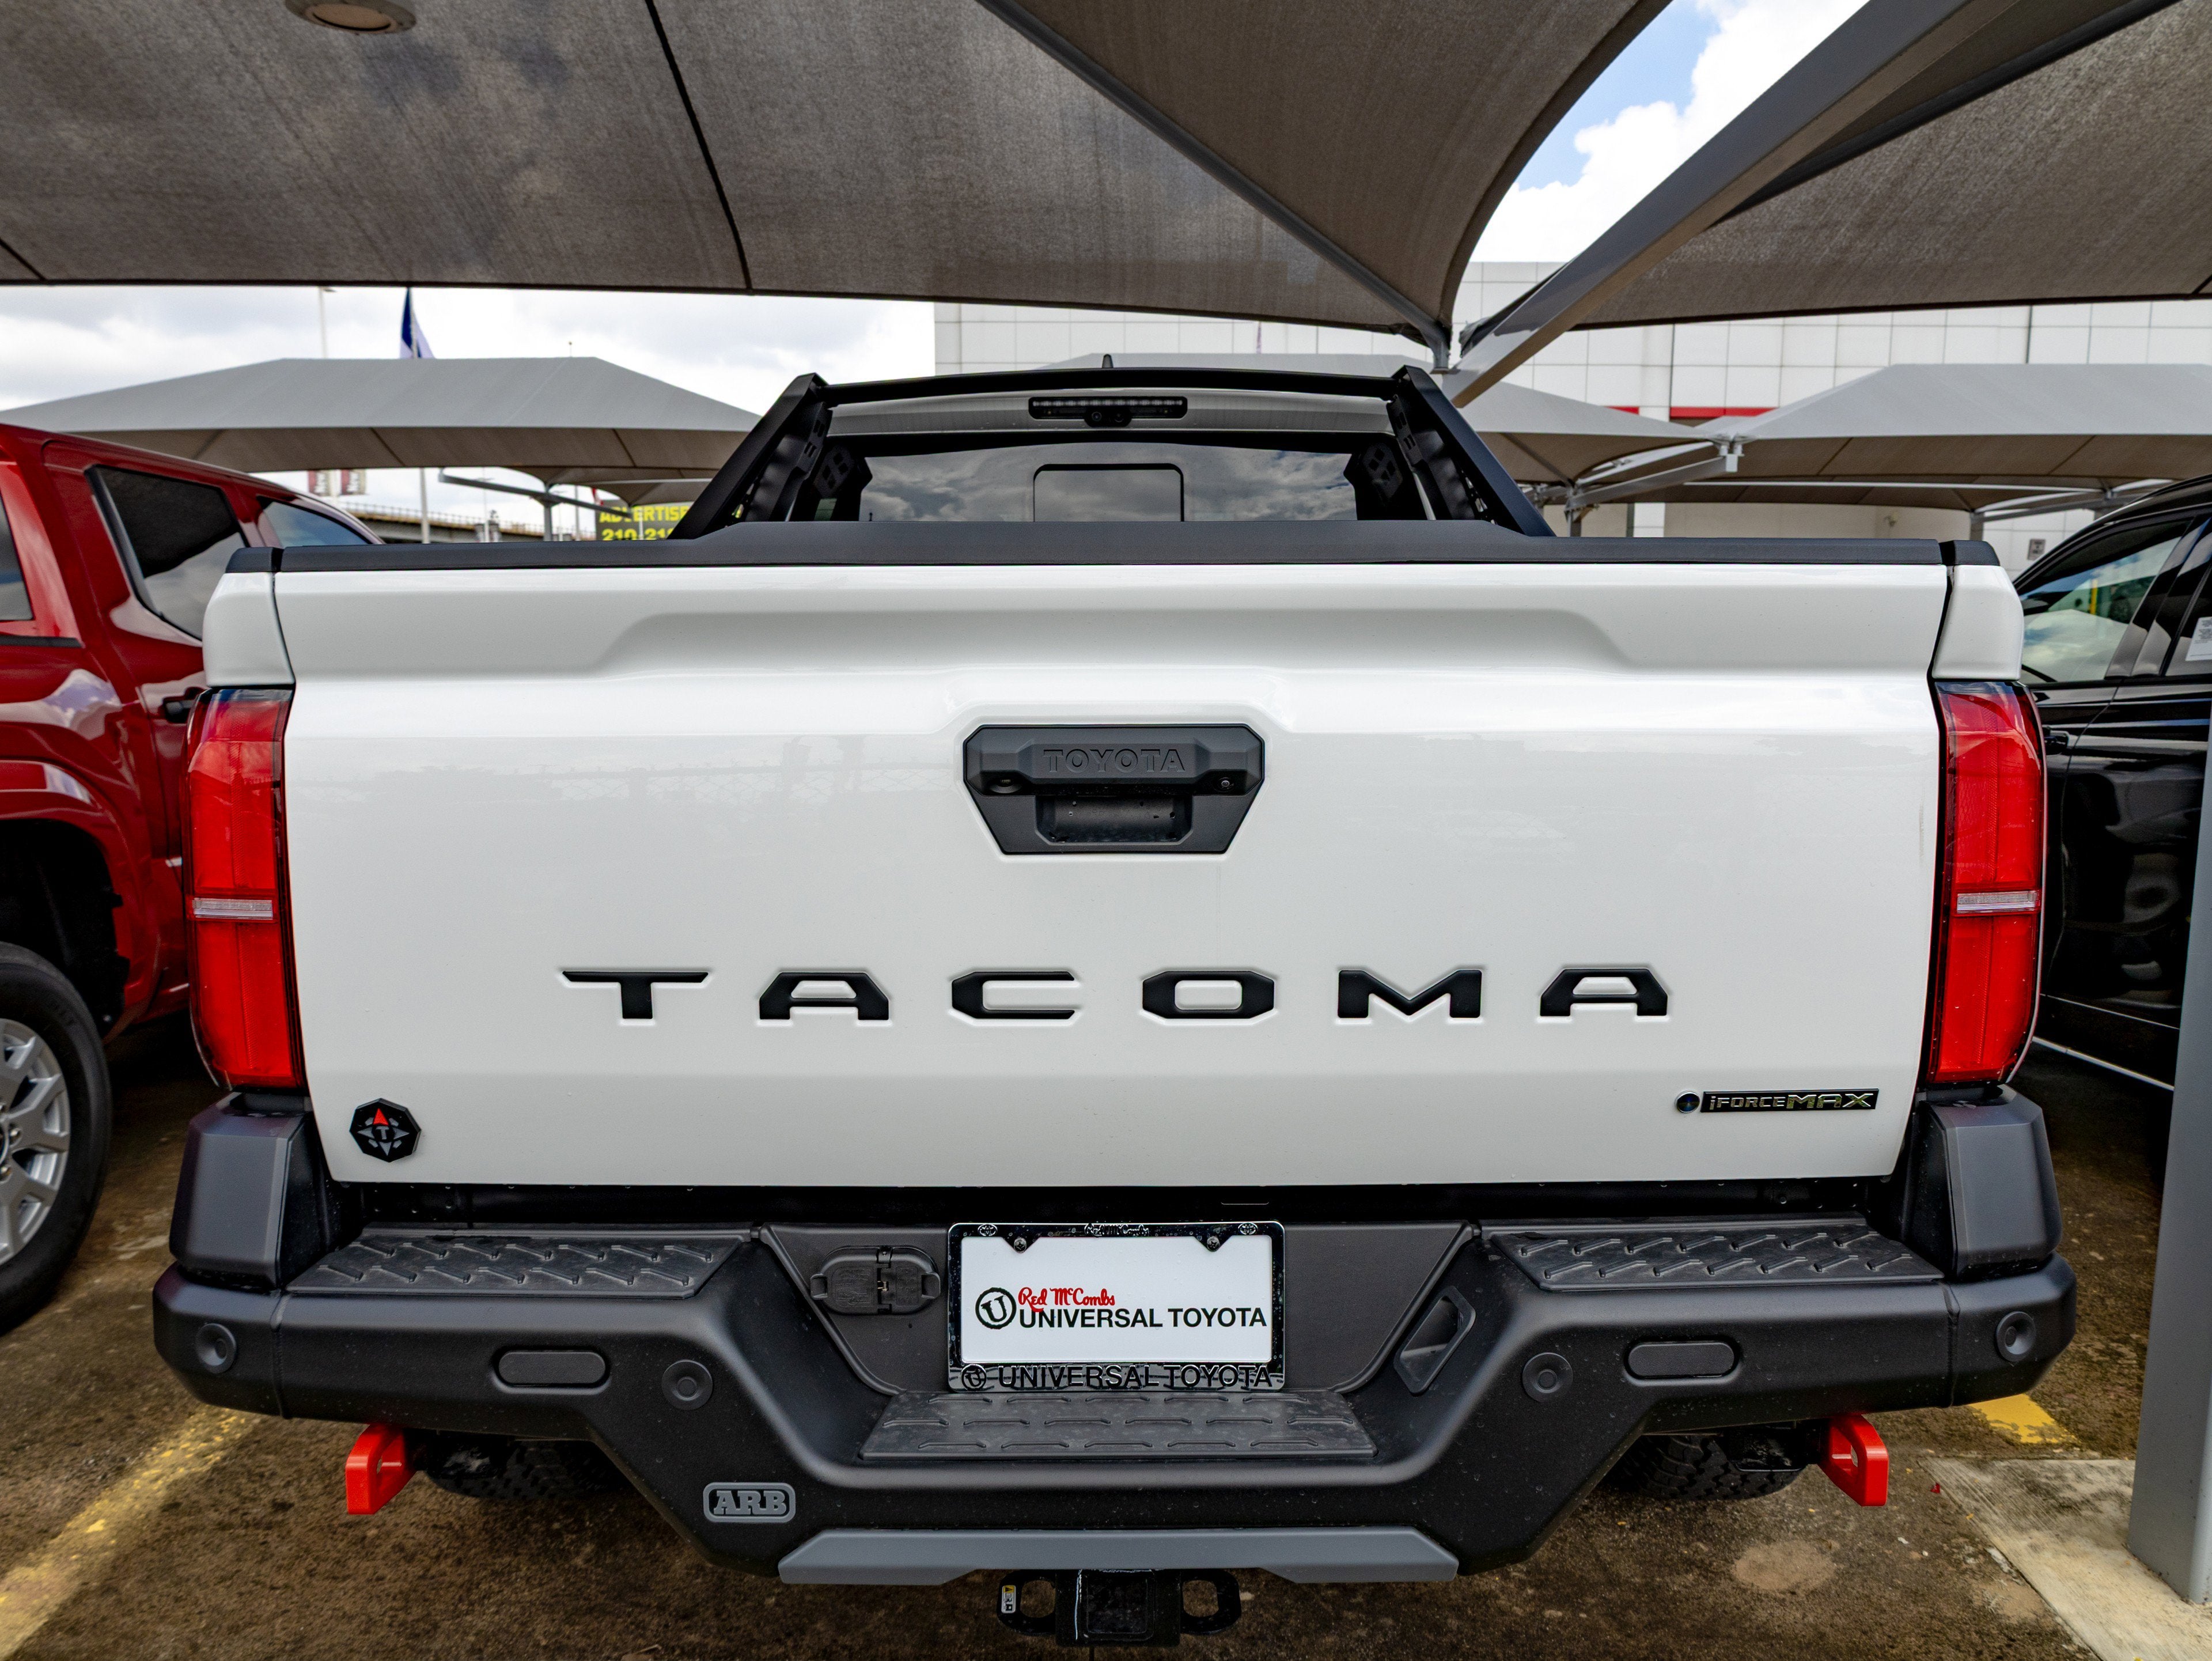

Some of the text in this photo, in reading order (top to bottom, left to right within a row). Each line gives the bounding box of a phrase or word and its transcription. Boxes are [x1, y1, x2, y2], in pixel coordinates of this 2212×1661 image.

[602, 528, 673, 540] 21021
[1043, 748, 1185, 773] TOYOTA
[562, 968, 1668, 1020] TACOMA
[1018, 1287, 1115, 1312] Red McCombs
[1020, 1307, 1267, 1328] UNIVERSAL TOYOTA
[998, 1365, 1272, 1388] UNIVERSAL TOYOTA
[714, 1490, 787, 1515] ARB
